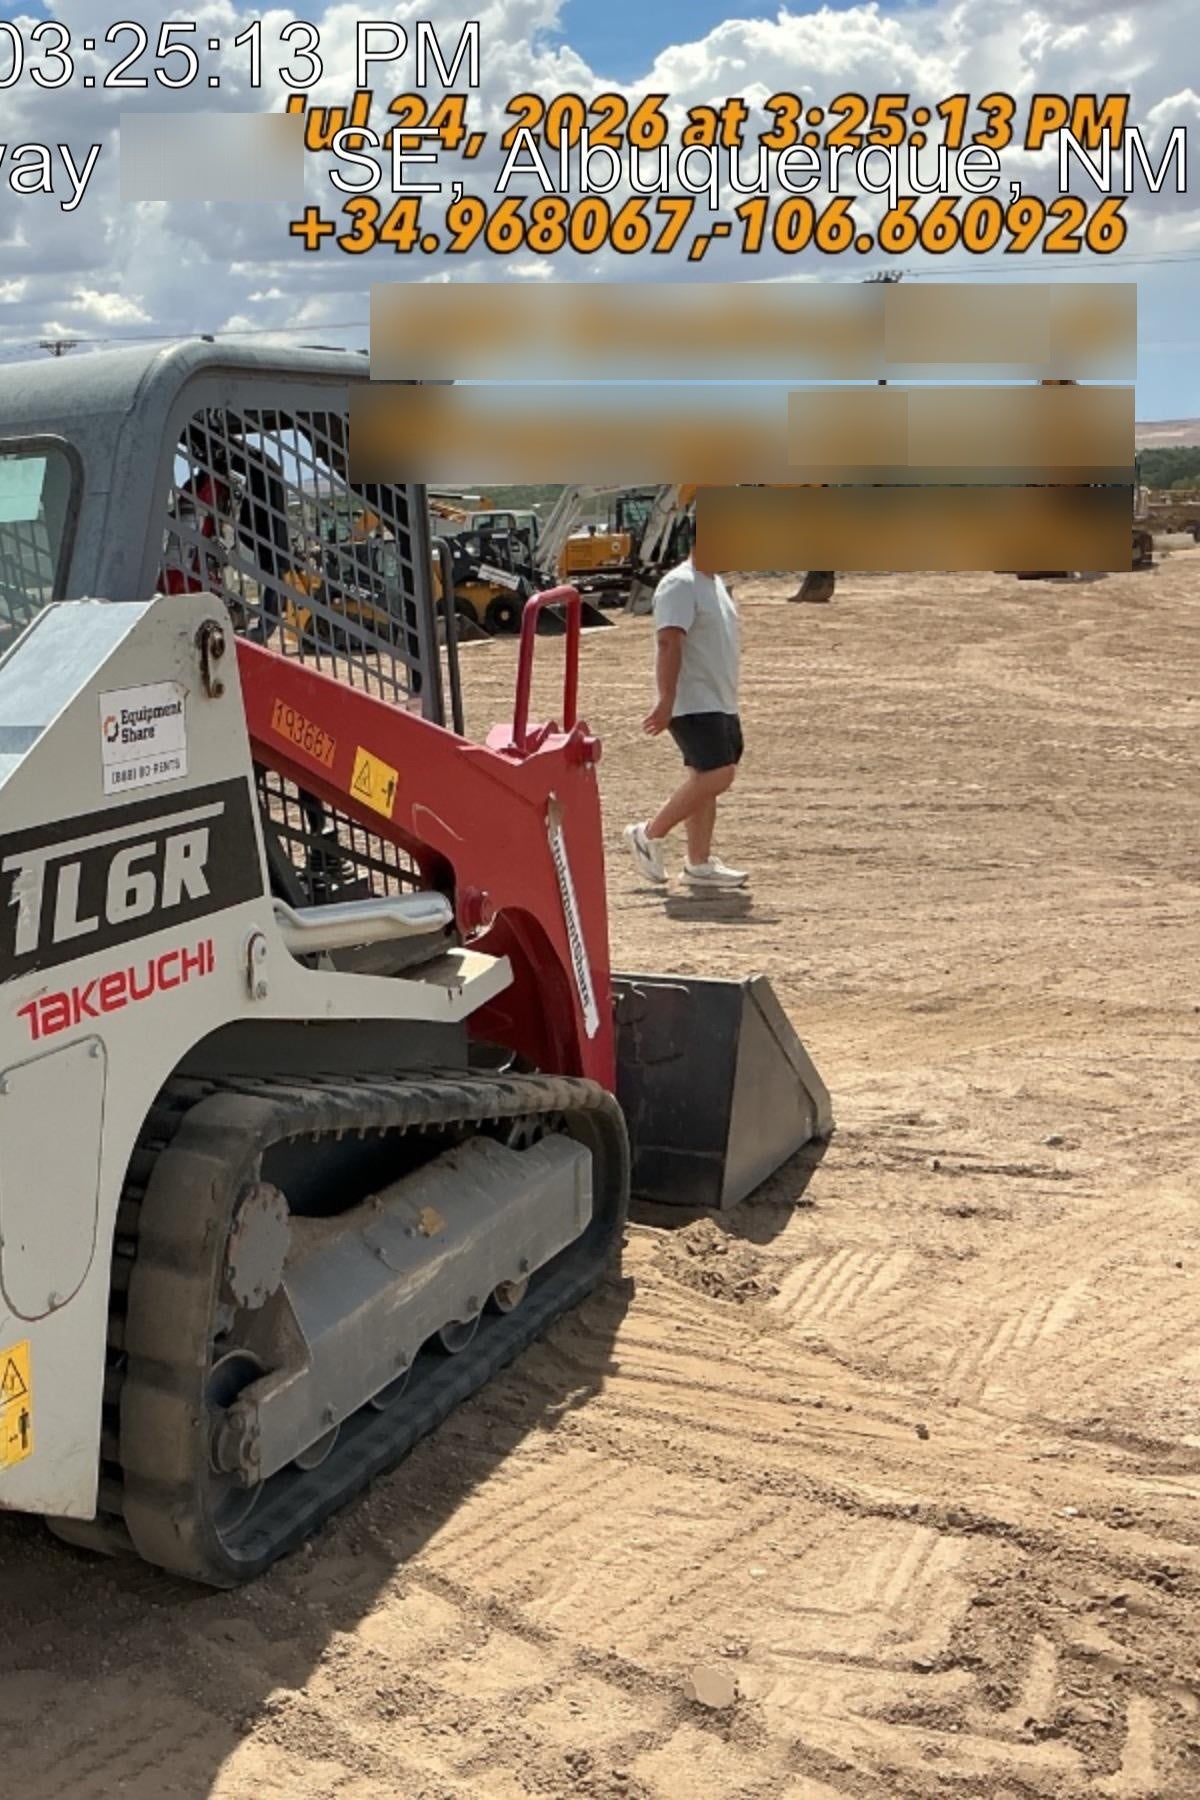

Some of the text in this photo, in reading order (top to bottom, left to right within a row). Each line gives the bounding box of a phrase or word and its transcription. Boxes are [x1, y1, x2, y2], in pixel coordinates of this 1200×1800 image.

[120, 700, 182, 726] Equipment
[275, 703, 336, 760] 193667
[121, 726, 155, 743] Share
[2, 801, 225, 957] TL6R
